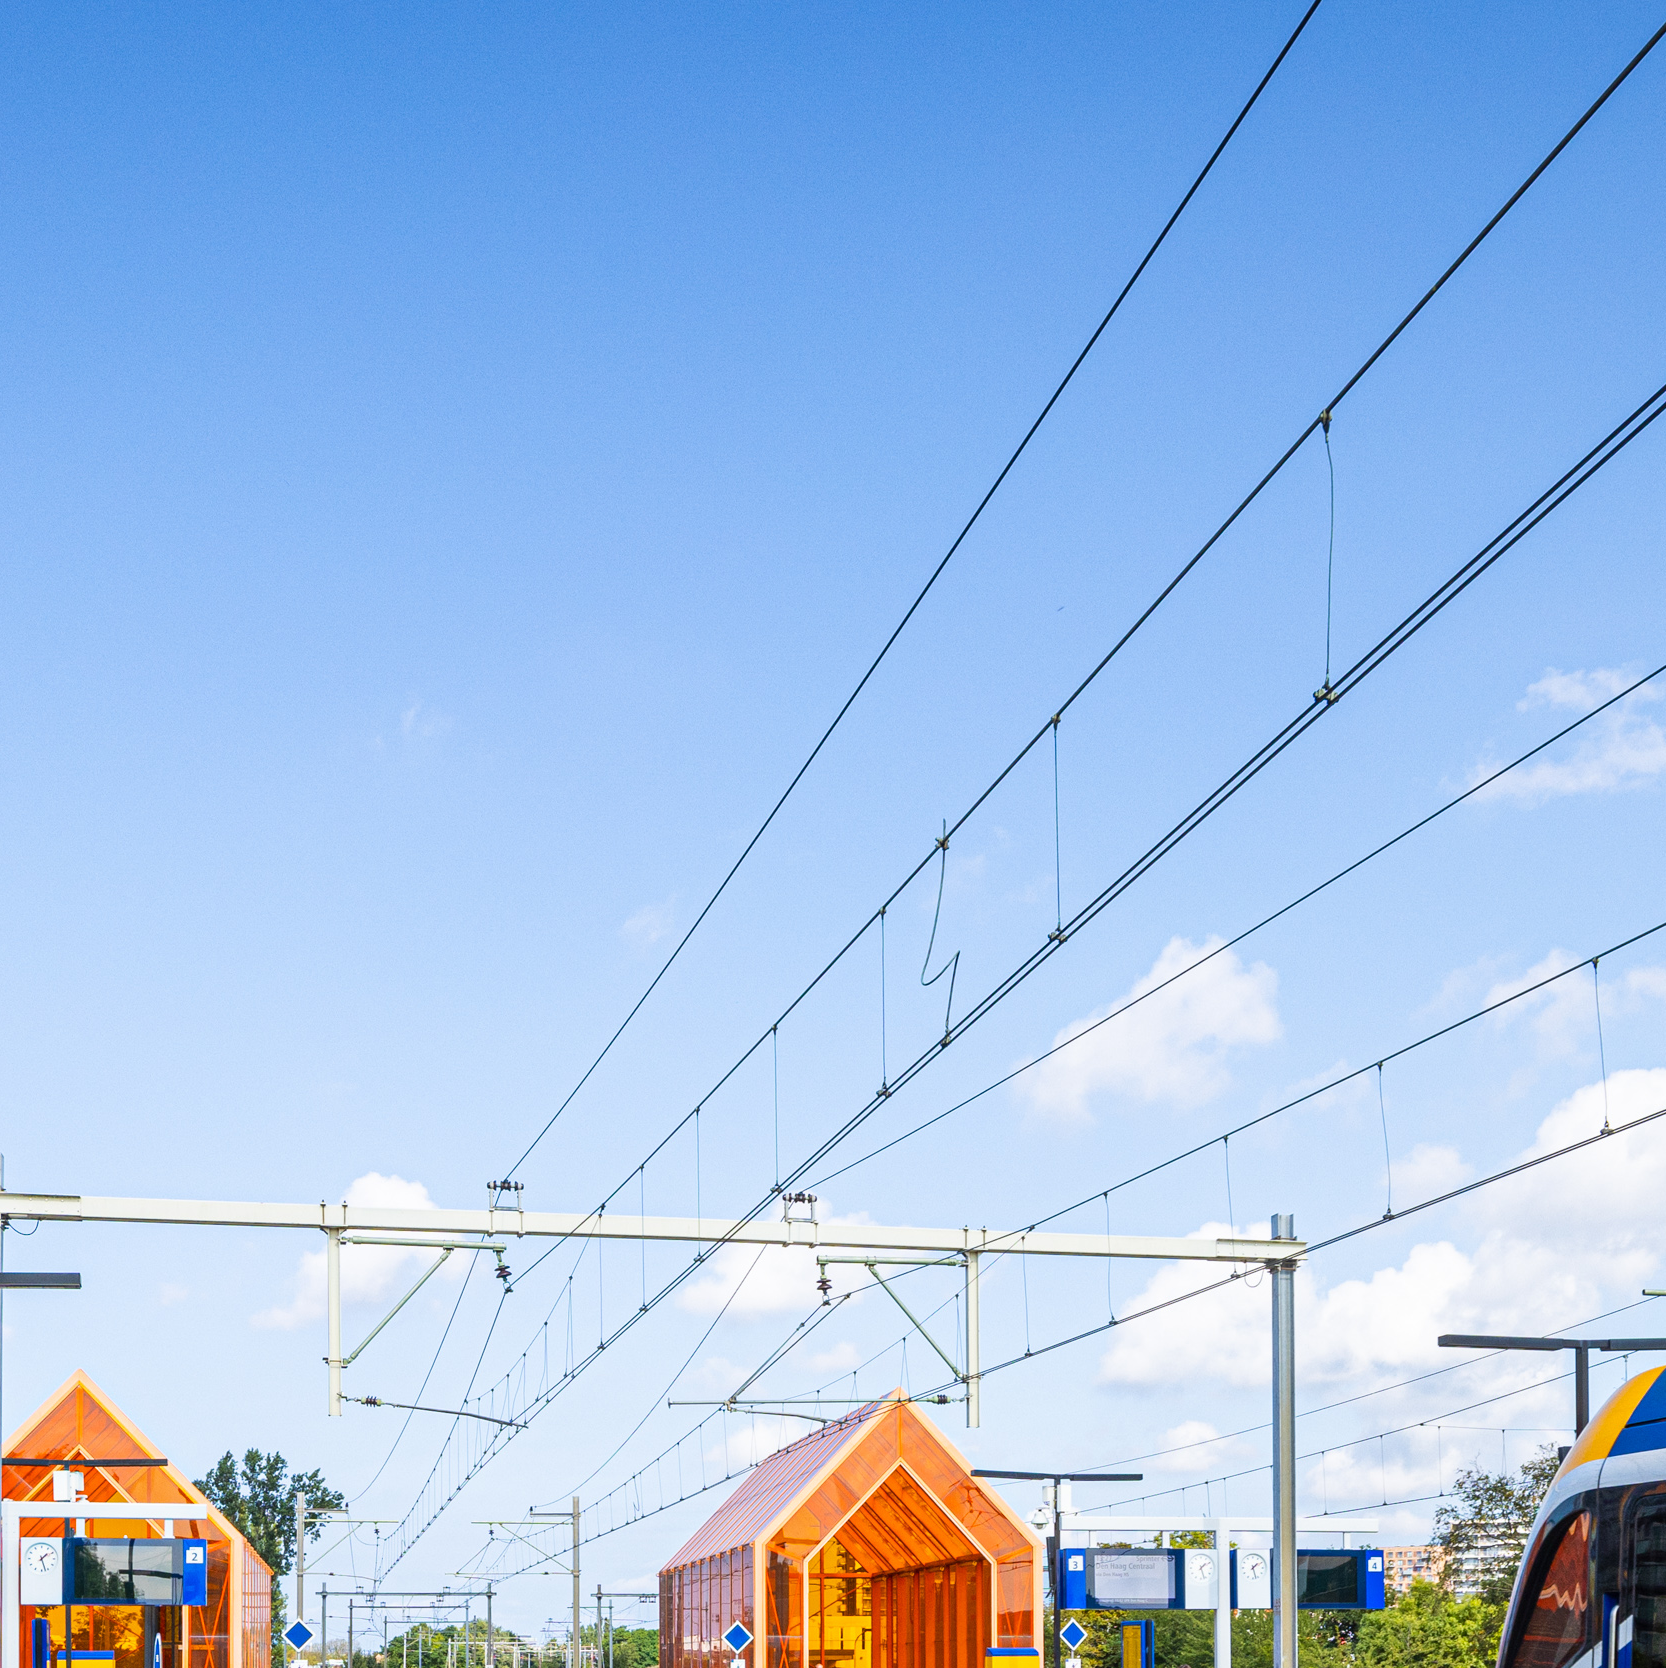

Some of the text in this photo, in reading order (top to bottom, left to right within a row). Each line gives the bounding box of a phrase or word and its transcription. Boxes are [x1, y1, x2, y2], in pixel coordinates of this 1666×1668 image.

[192, 1553, 197, 1561] 2
[1073, 1561, 1078, 1569] 3
[1110, 1563, 1127, 1571] Haag
